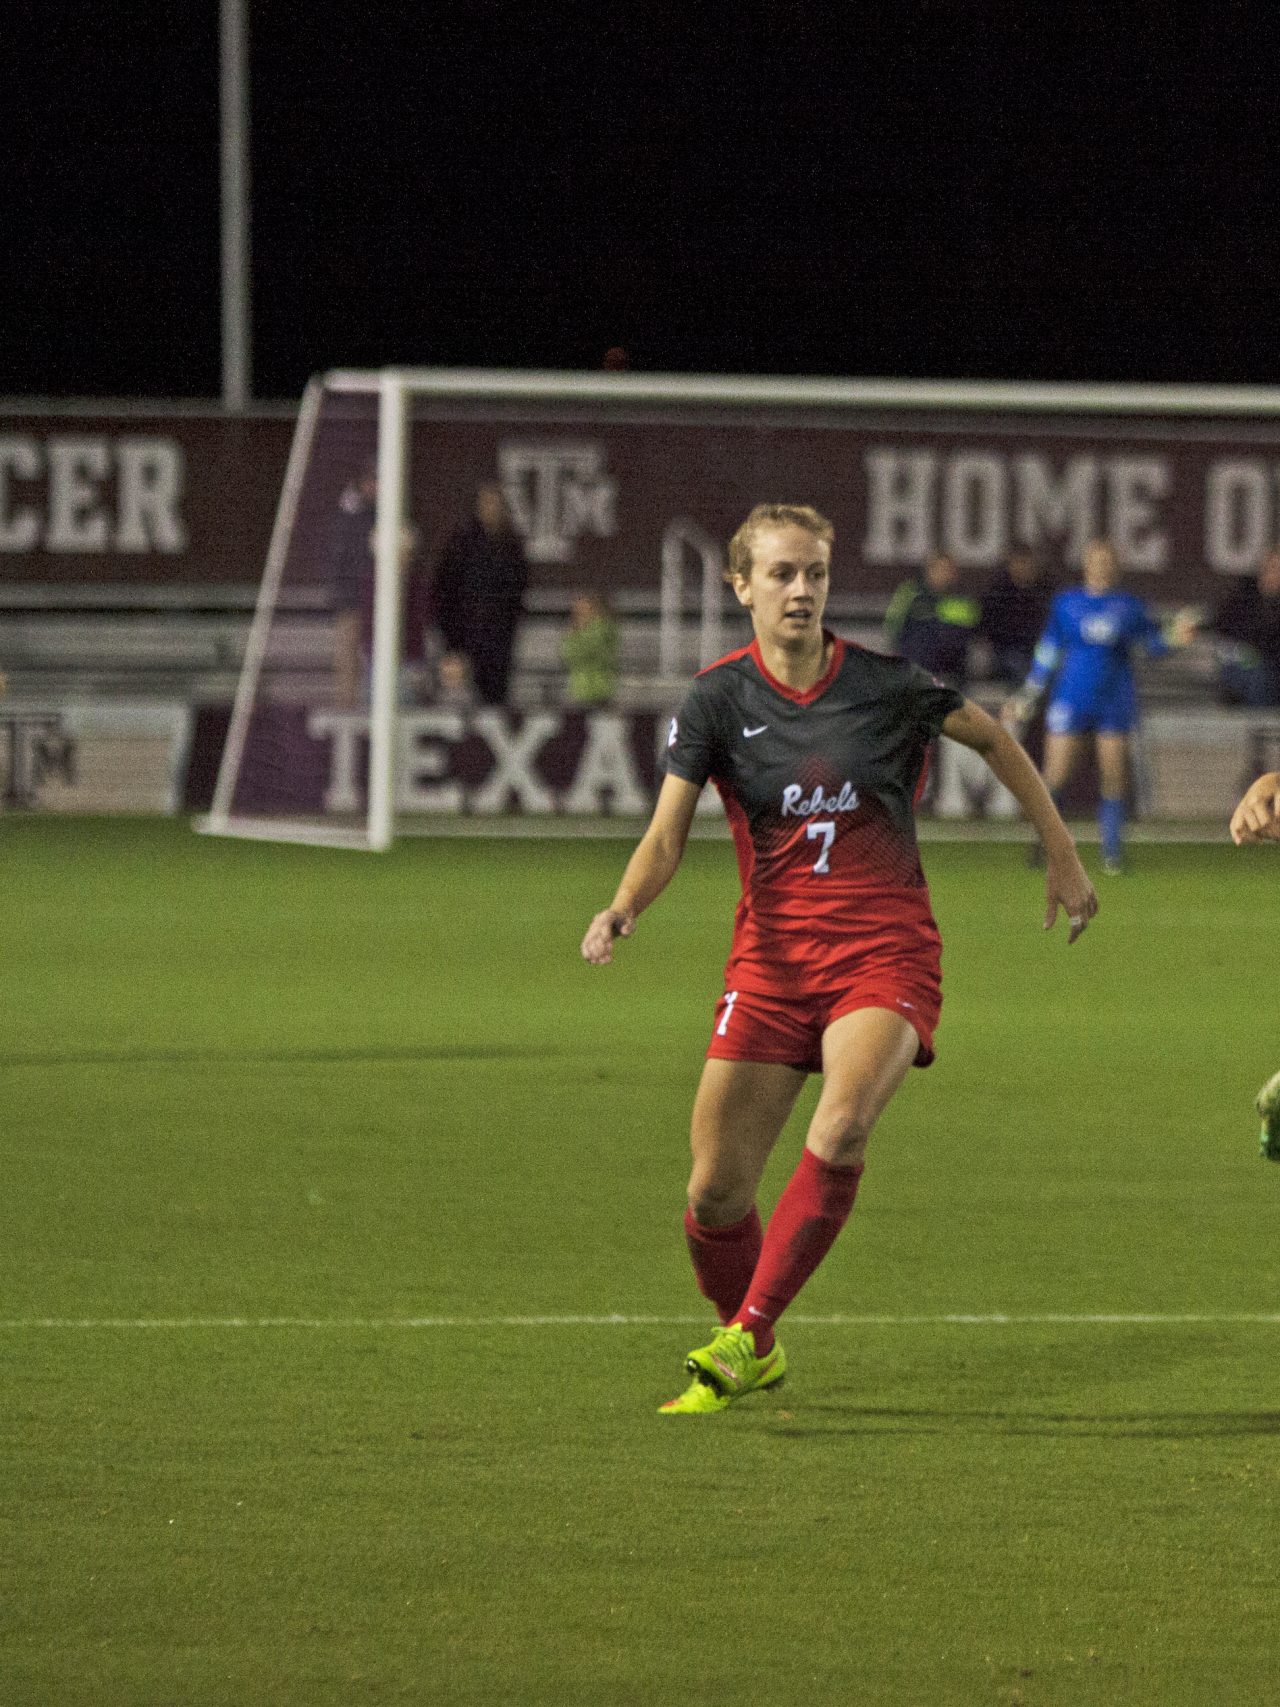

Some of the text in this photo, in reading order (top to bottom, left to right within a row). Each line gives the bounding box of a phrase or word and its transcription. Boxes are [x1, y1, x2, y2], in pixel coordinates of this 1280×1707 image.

[0, 437, 184, 553] CER
[864, 447, 1170, 572] HOME
[781, 781, 861, 817] Rebels
[806, 821, 836, 874] 7
